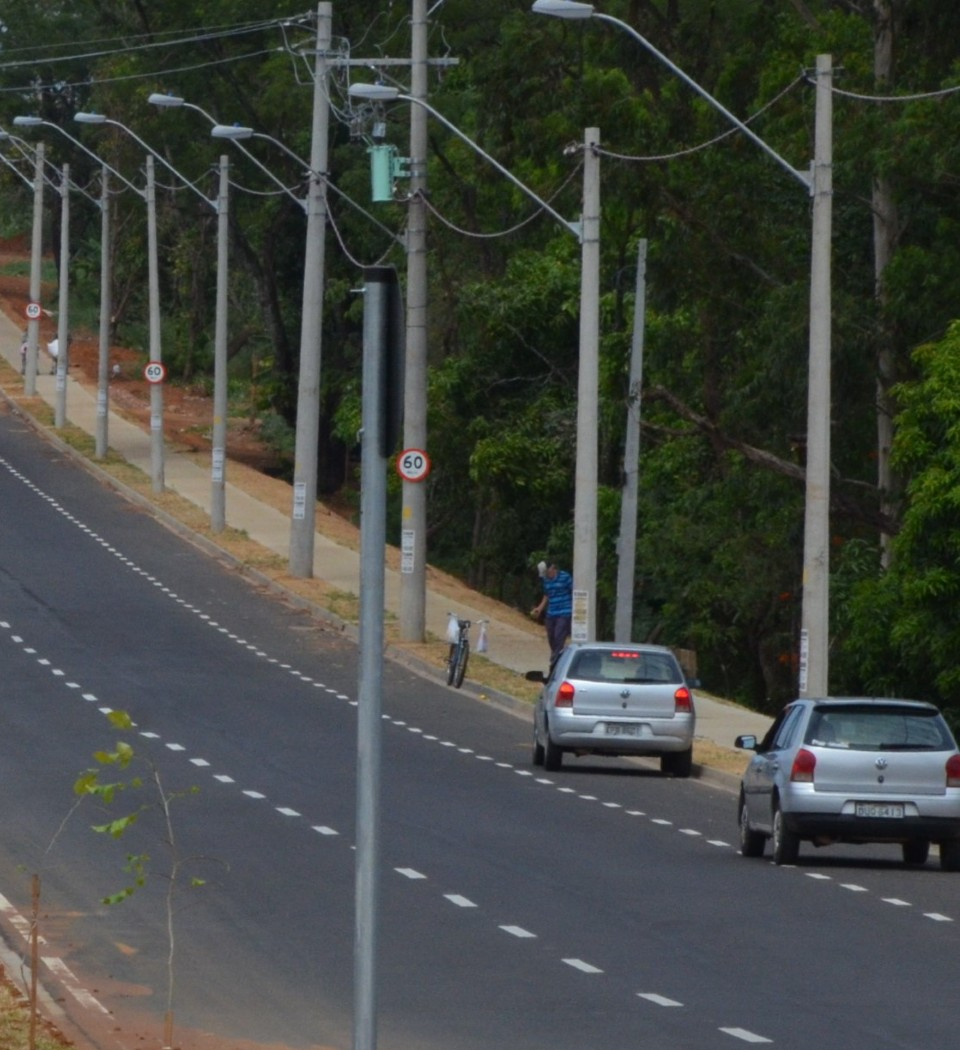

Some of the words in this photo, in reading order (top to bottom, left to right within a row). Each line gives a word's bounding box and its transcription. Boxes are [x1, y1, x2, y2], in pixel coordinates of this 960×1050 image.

[28, 306, 38, 314] 60
[148, 367, 161, 376] 60
[403, 455, 423, 469] 60
